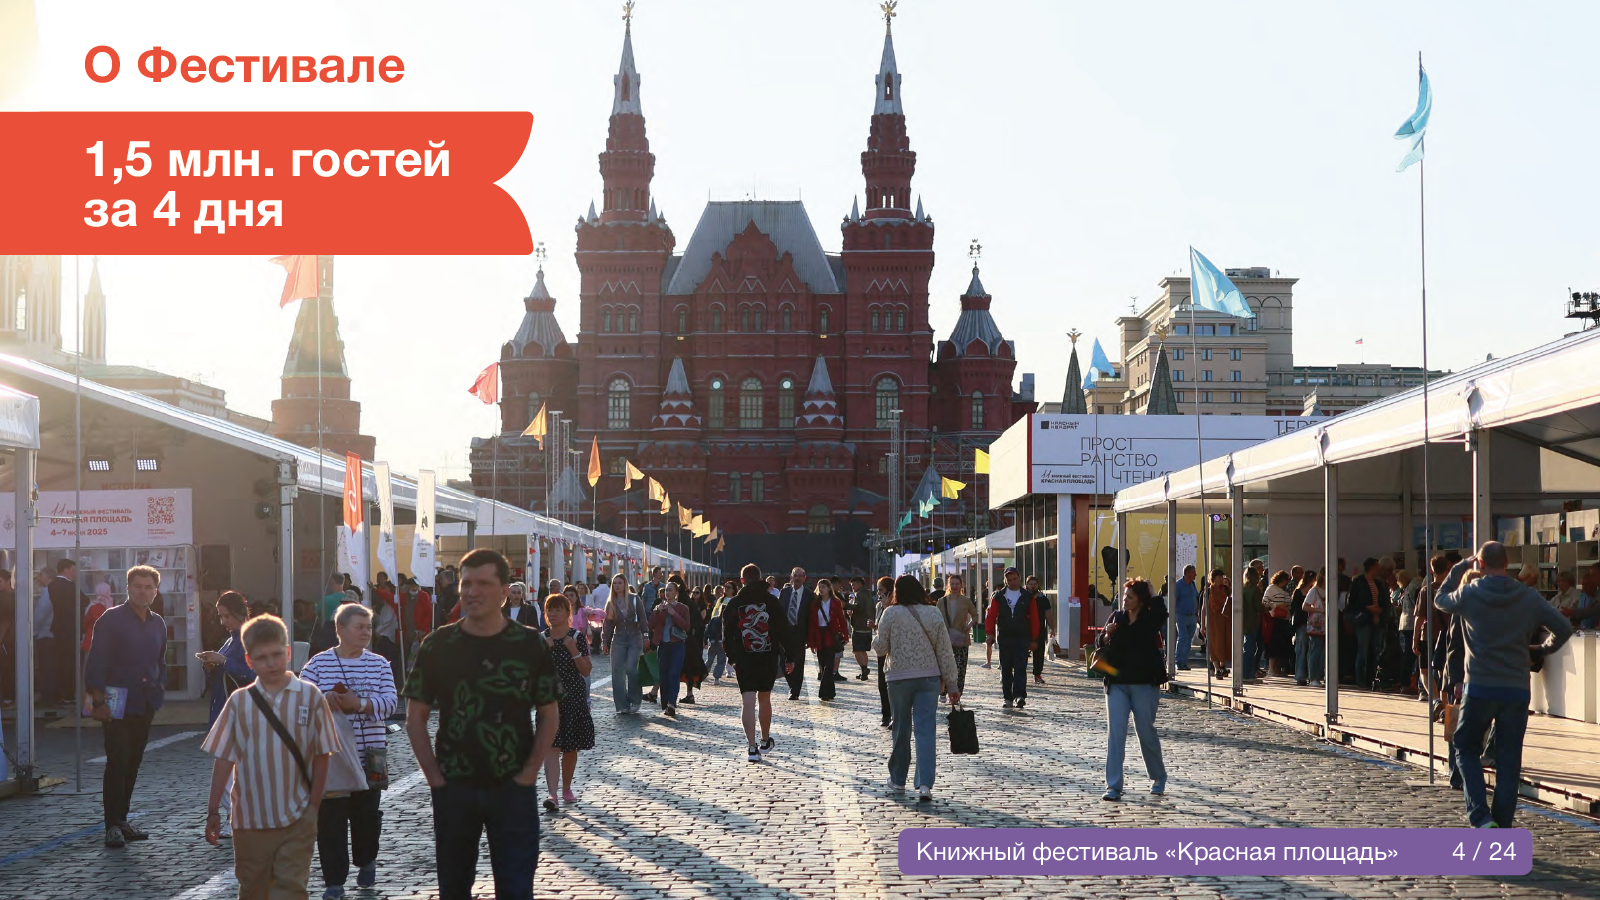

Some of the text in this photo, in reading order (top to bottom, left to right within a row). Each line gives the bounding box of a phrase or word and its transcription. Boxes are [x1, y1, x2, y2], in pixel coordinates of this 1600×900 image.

[1080, 437, 1134, 451] ПРОСТ
[1080, 453, 1158, 467] РАНСТВО
[1111, 470, 1176, 484] ЧТЕНИ
[89, 515, 133, 524] ПЛОЩАДЬ
[87, 528, 108, 536] 2025
